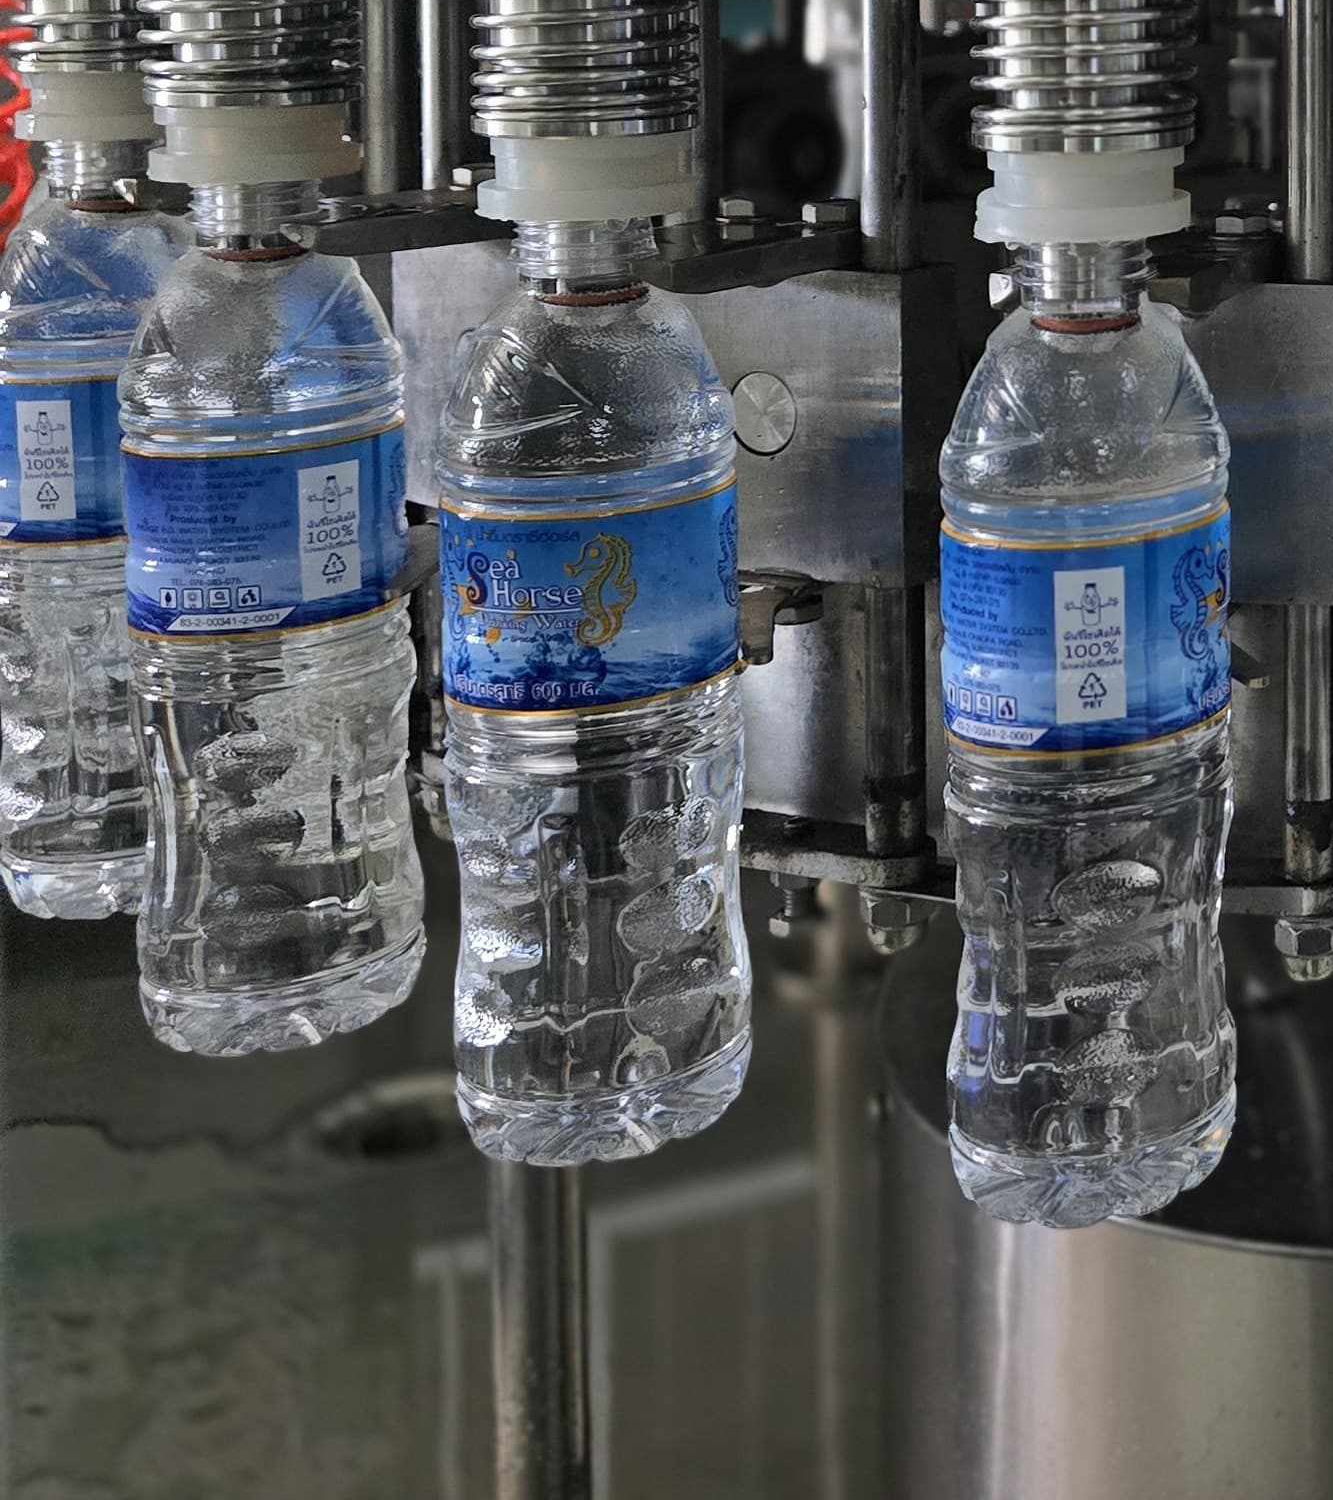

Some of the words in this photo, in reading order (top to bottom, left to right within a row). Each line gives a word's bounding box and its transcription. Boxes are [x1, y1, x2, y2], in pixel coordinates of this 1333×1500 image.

[26, 457, 69, 470] 100%
[307, 523, 354, 544] 100%
[466, 551, 520, 605] Sea
[492, 580, 583, 607] Horse
[1065, 639, 1119, 659] 100%
[531, 682, 562, 701] 600
[1083, 700, 1102, 710] PET
